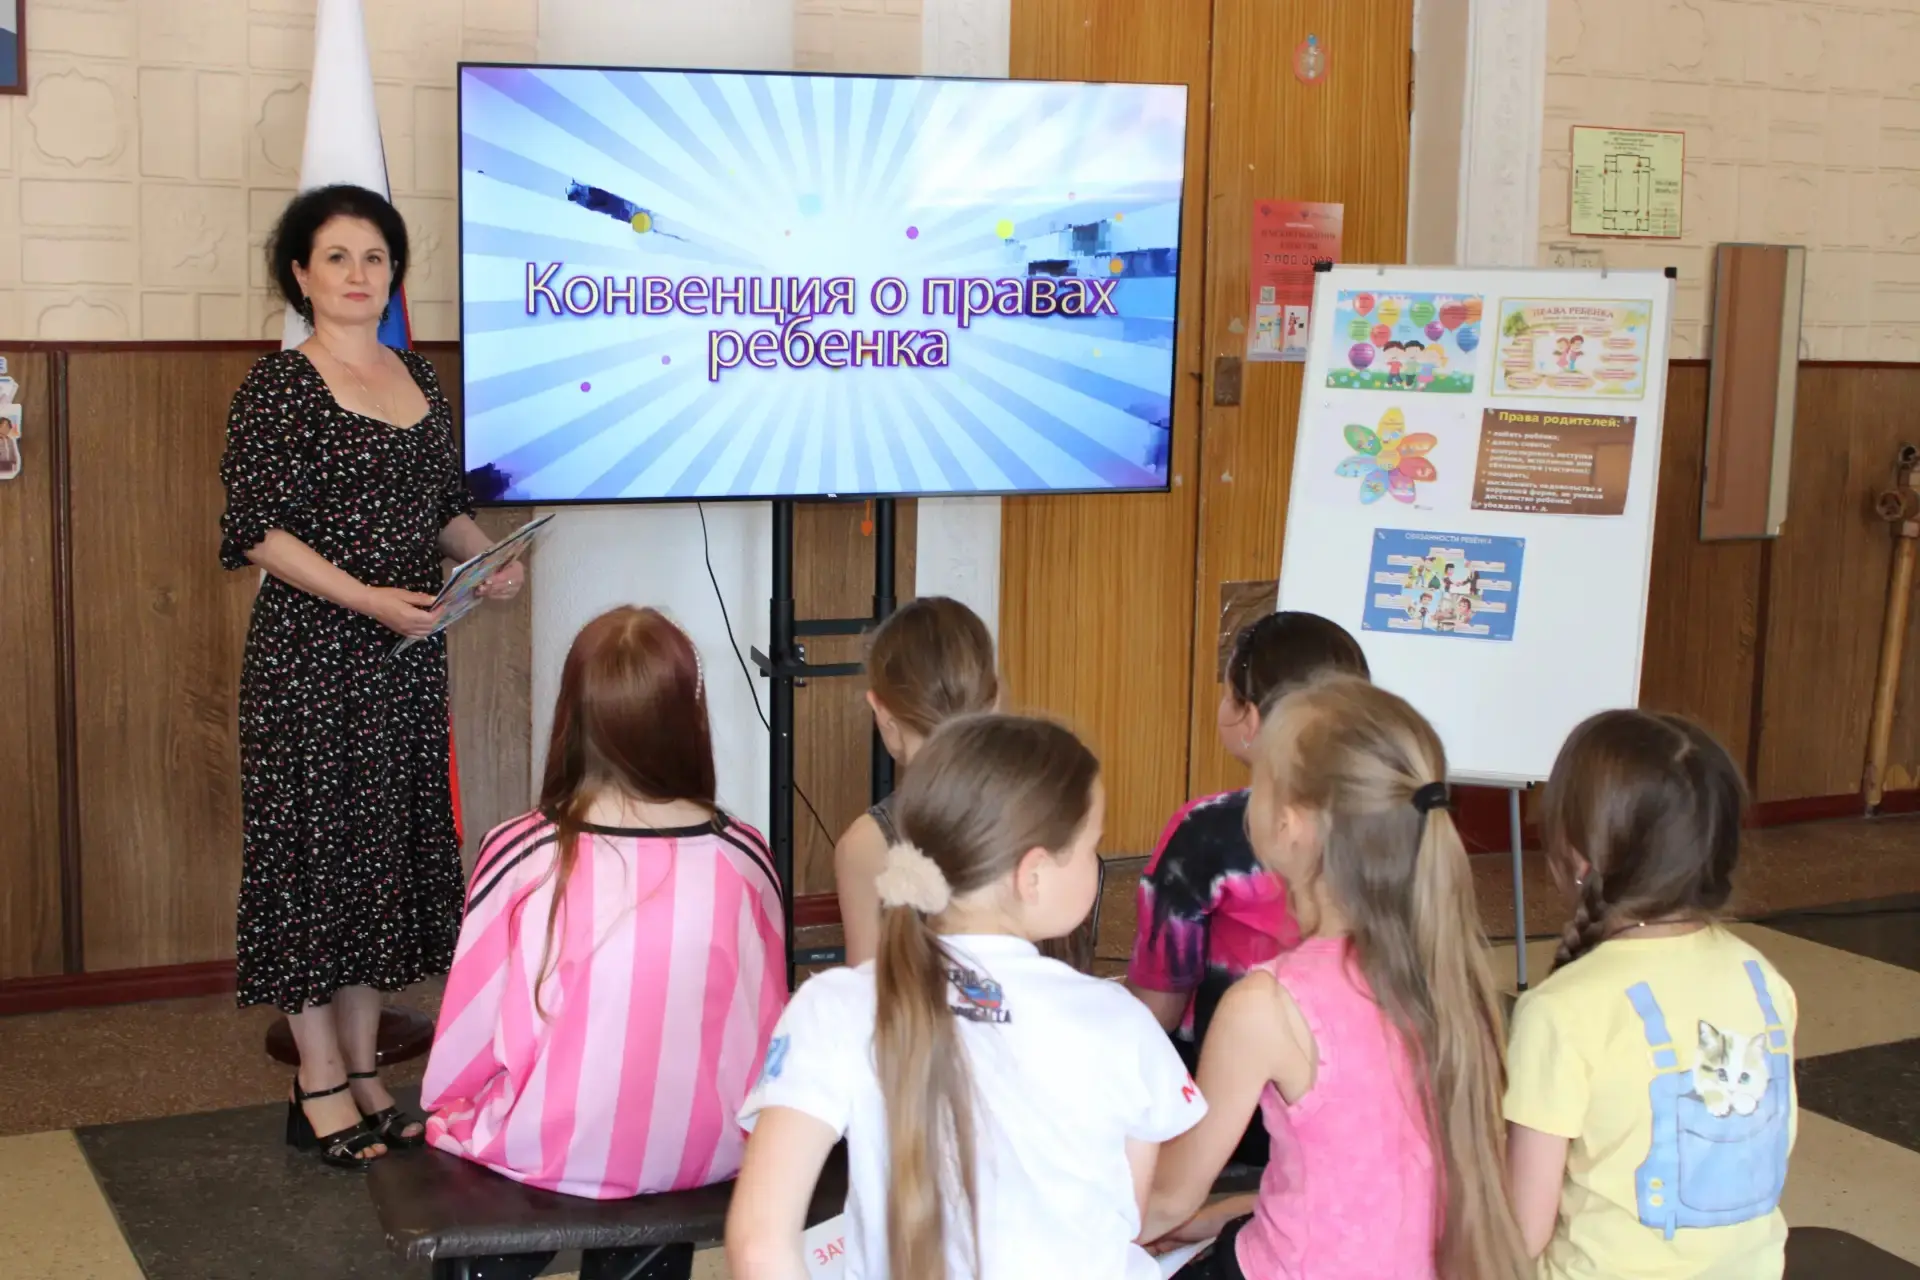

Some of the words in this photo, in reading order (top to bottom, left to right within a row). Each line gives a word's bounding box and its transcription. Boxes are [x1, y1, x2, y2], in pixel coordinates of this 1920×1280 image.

[525, 261, 855, 322] Конвенция
[870, 274, 907, 315] о
[921, 274, 1120, 328] правах
[707, 315, 951, 381] ребенка
[1499, 411, 1540, 424] Права
[1543, 414, 1621, 428] родителей:
